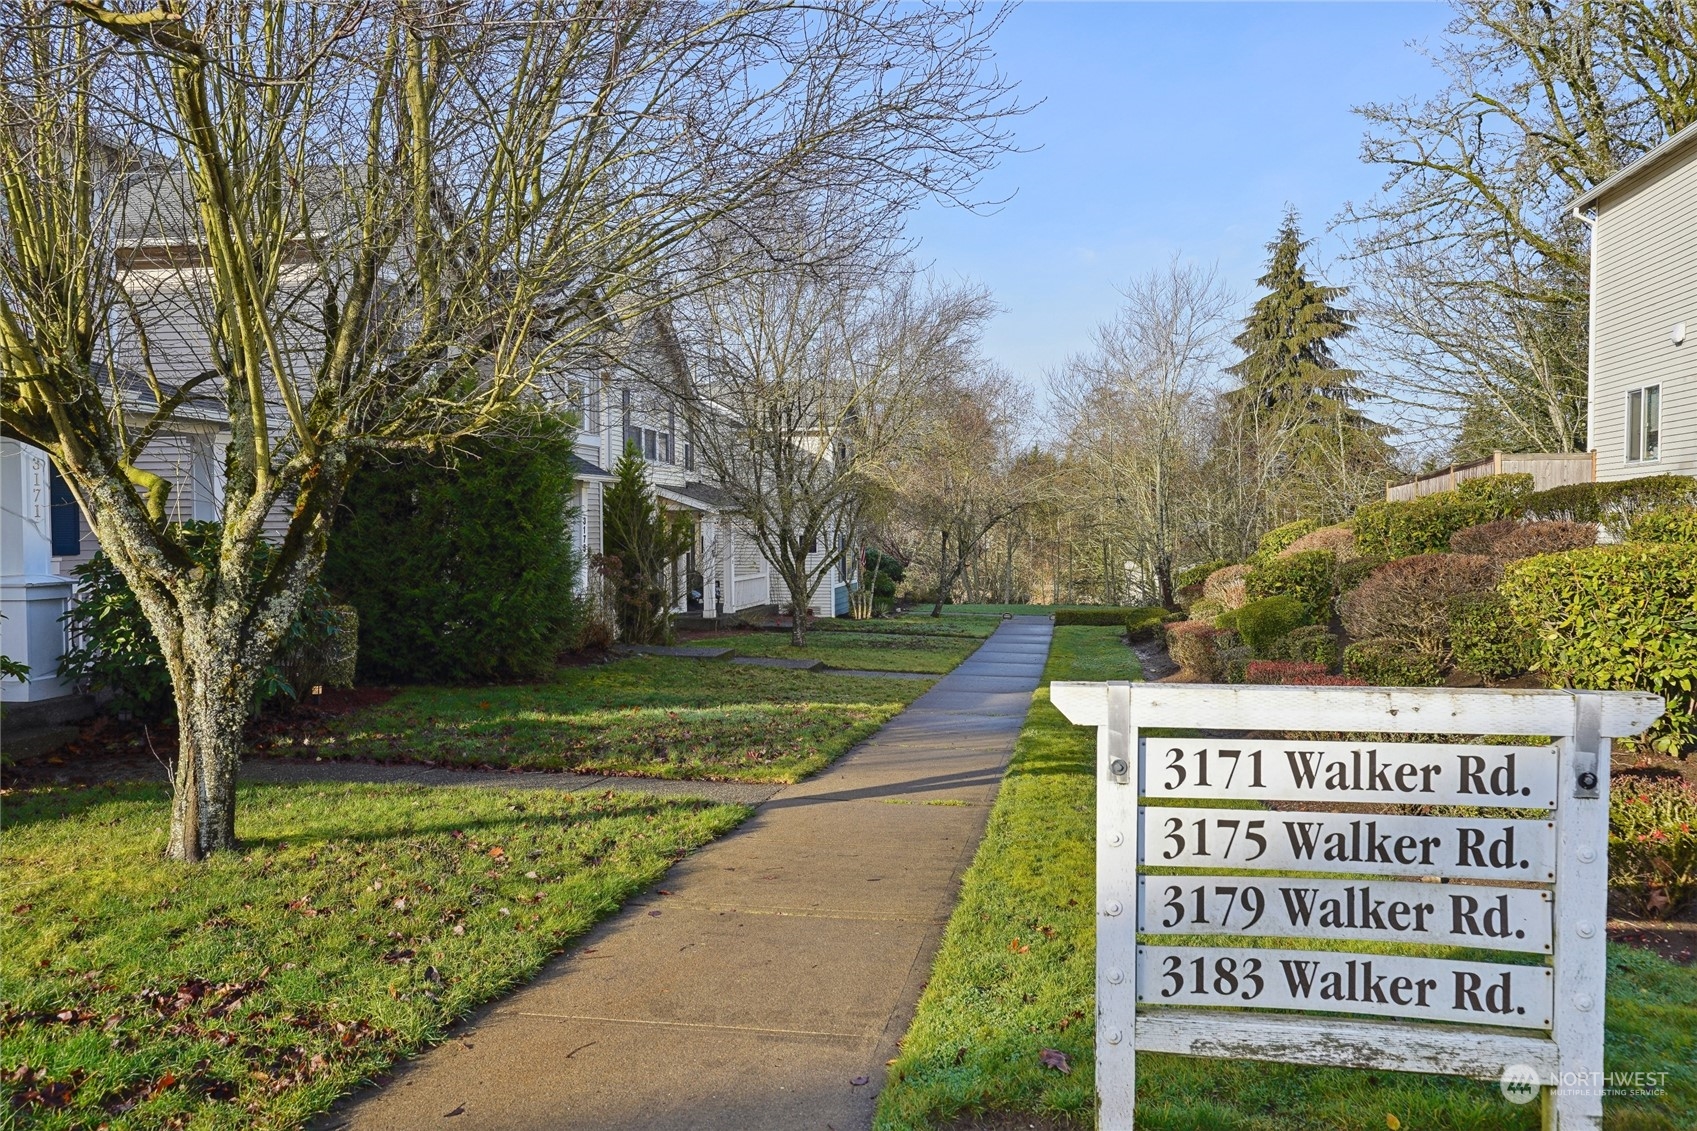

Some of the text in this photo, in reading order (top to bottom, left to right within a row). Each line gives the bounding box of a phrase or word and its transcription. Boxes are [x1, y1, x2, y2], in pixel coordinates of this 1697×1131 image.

[32, 457, 41, 518] 3171
[1164, 748, 1531, 797] 3171 Walker Rd.
[1163, 817, 1530, 870] 3175 Walker Rd.
[1162, 885, 1525, 940] 3179 Walker Rd.
[1160, 955, 1526, 1016] 3183 Walker Rd.
